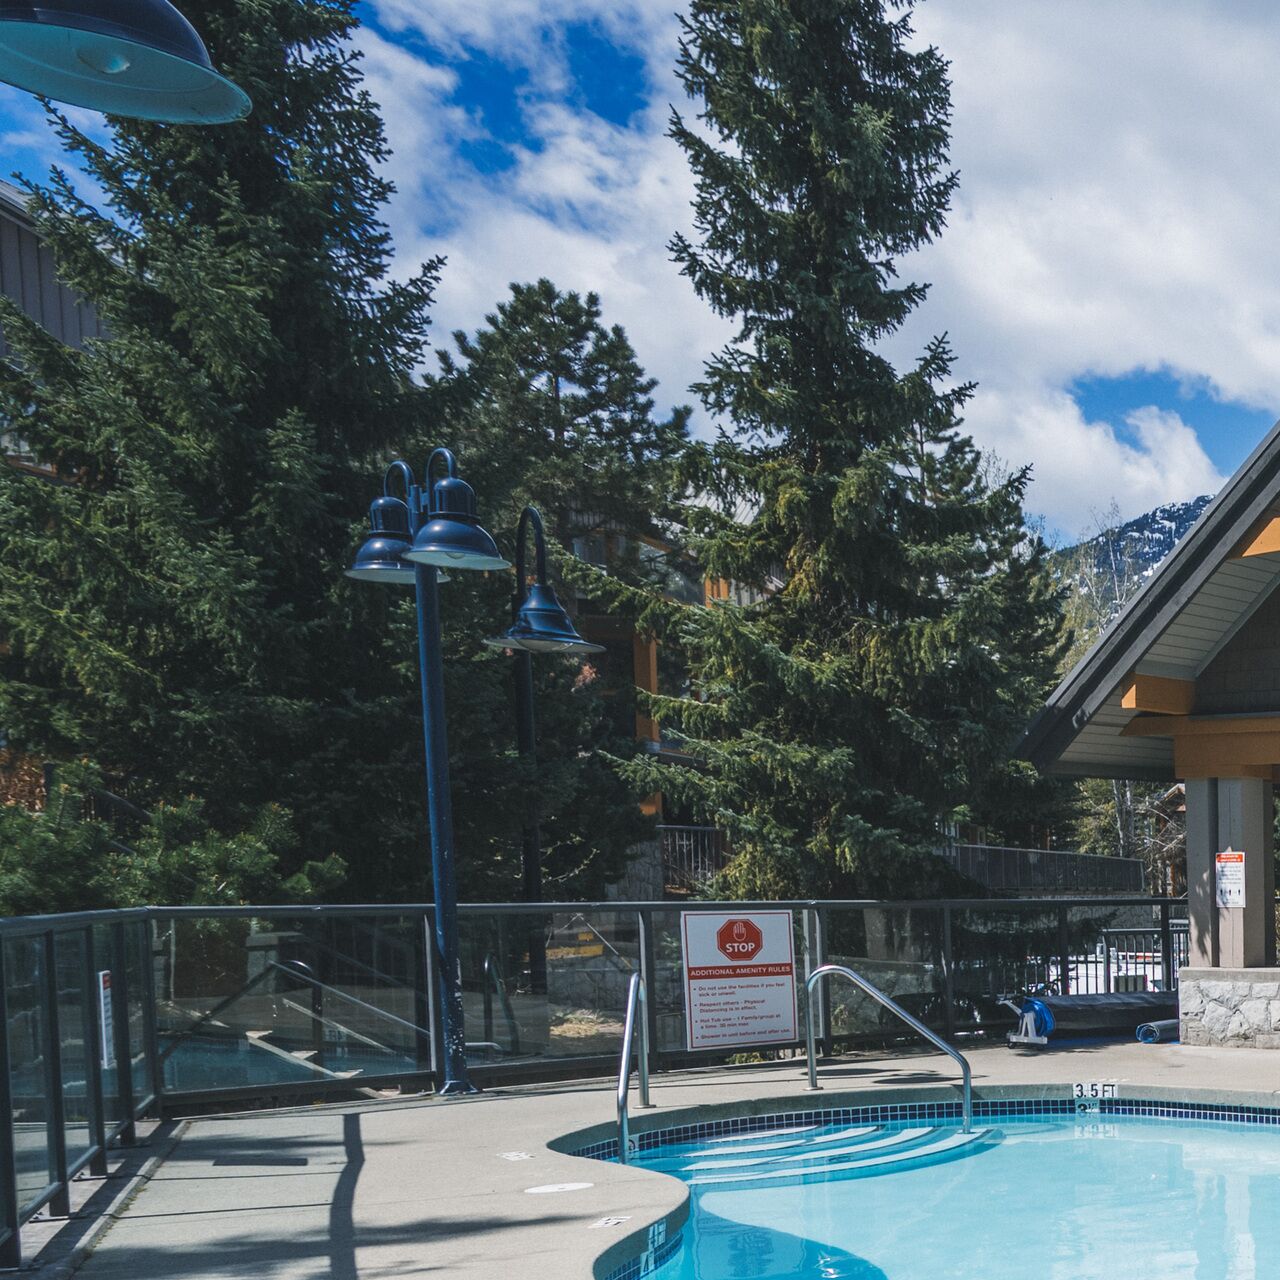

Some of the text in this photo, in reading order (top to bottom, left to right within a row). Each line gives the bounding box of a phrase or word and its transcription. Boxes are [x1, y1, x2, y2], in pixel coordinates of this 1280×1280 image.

[725, 943, 755, 953] STOP
[691, 965, 790, 977] ADDITIONAL AMENITY RULES
[1102, 1084, 1115, 1098] FT
